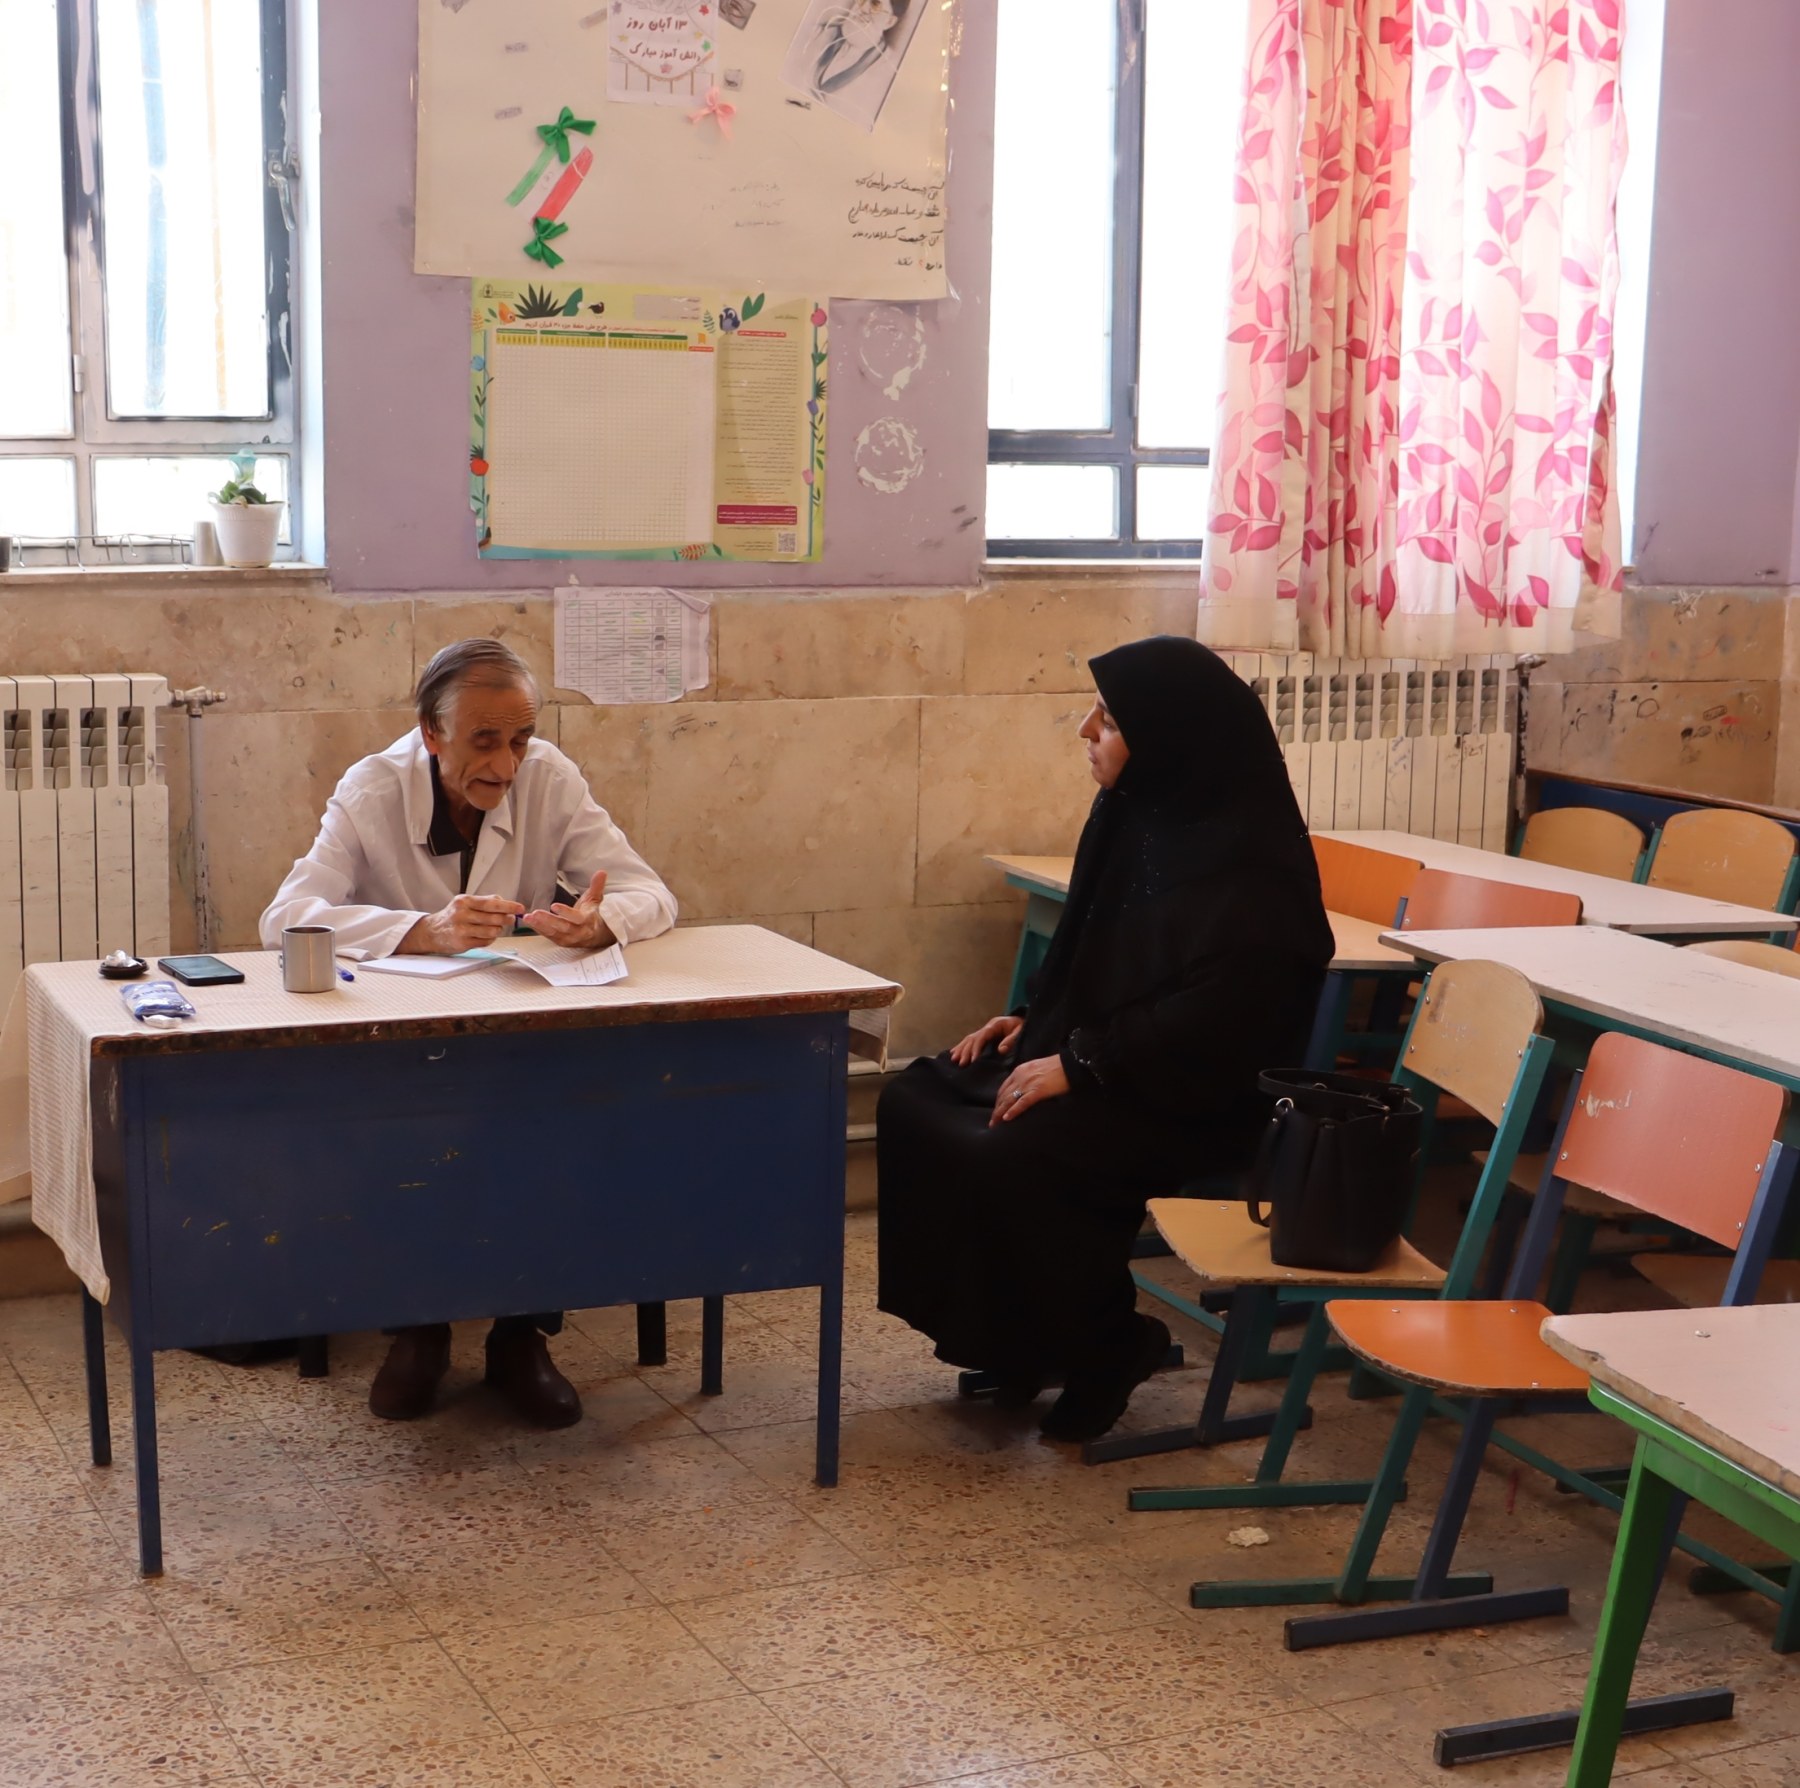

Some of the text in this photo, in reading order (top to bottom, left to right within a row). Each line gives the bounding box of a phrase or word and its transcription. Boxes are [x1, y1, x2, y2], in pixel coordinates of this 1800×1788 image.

[626, 17, 644, 30] روز
[649, 17, 672, 32] آبان
[660, 48, 678, 59] آموز
